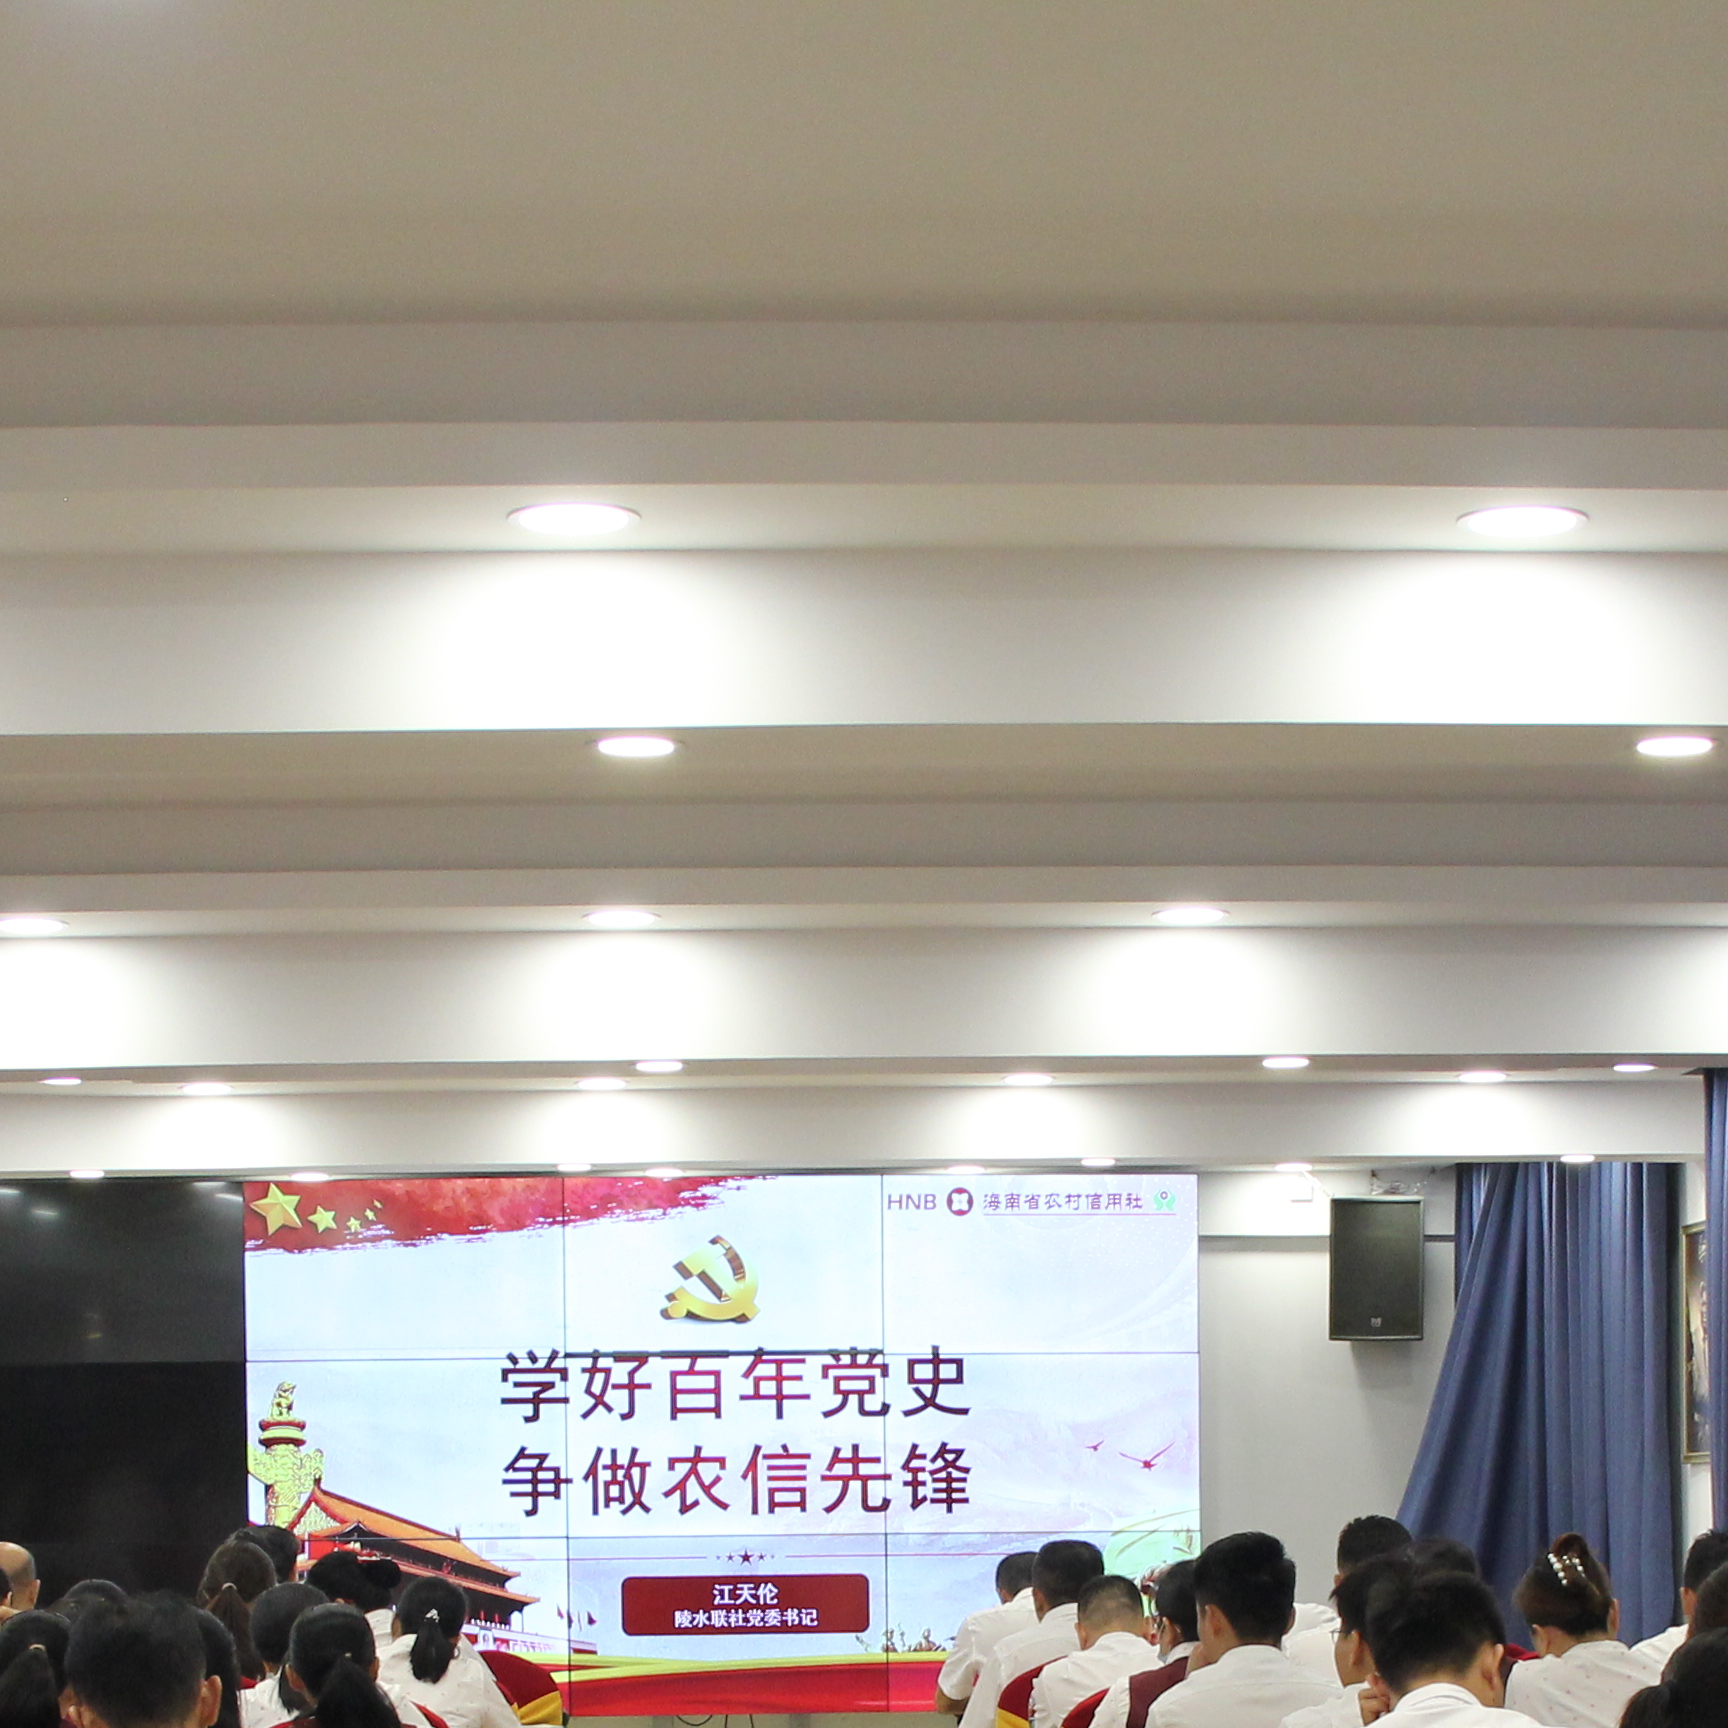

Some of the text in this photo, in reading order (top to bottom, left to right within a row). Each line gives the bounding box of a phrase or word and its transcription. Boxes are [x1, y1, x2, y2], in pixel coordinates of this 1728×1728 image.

[887, 1192, 1143, 1211] HNB 海南省农村信用社
[500, 1345, 971, 1423] 学好百年党史
[502, 1441, 972, 1517] 争做农信先锋
[712, 1583, 780, 1606] 江天伦
[673, 1607, 819, 1629] 陵水联社党委书记
